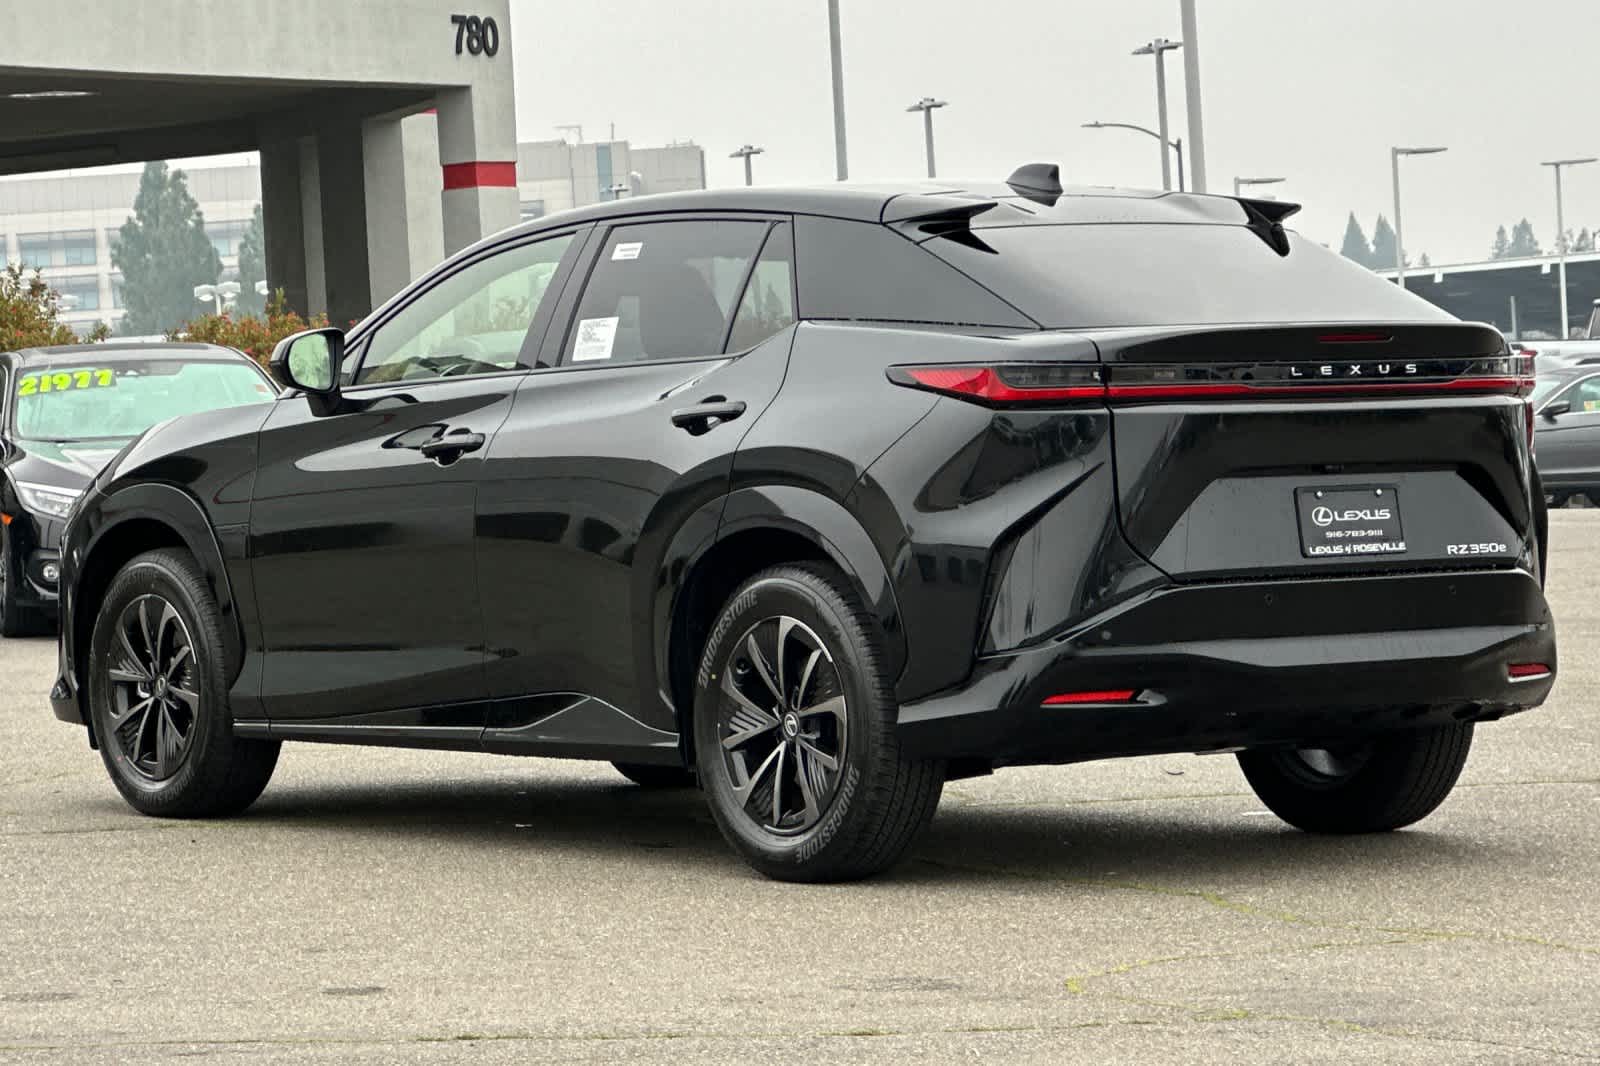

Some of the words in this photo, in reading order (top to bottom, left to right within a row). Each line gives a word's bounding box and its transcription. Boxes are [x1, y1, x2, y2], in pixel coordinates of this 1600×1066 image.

[451, 14, 499, 57] 780
[1291, 364, 1417, 377] LEXUS
[18, 368, 113, 396] 21977
[1334, 509, 1391, 521] LEXUS
[1325, 529, 1383, 538] 916-783-9111
[1309, 545, 1343, 555] LEXUS
[1353, 541, 1407, 553] ROSEVILLE
[698, 590, 758, 688] BRIDGESTONE
